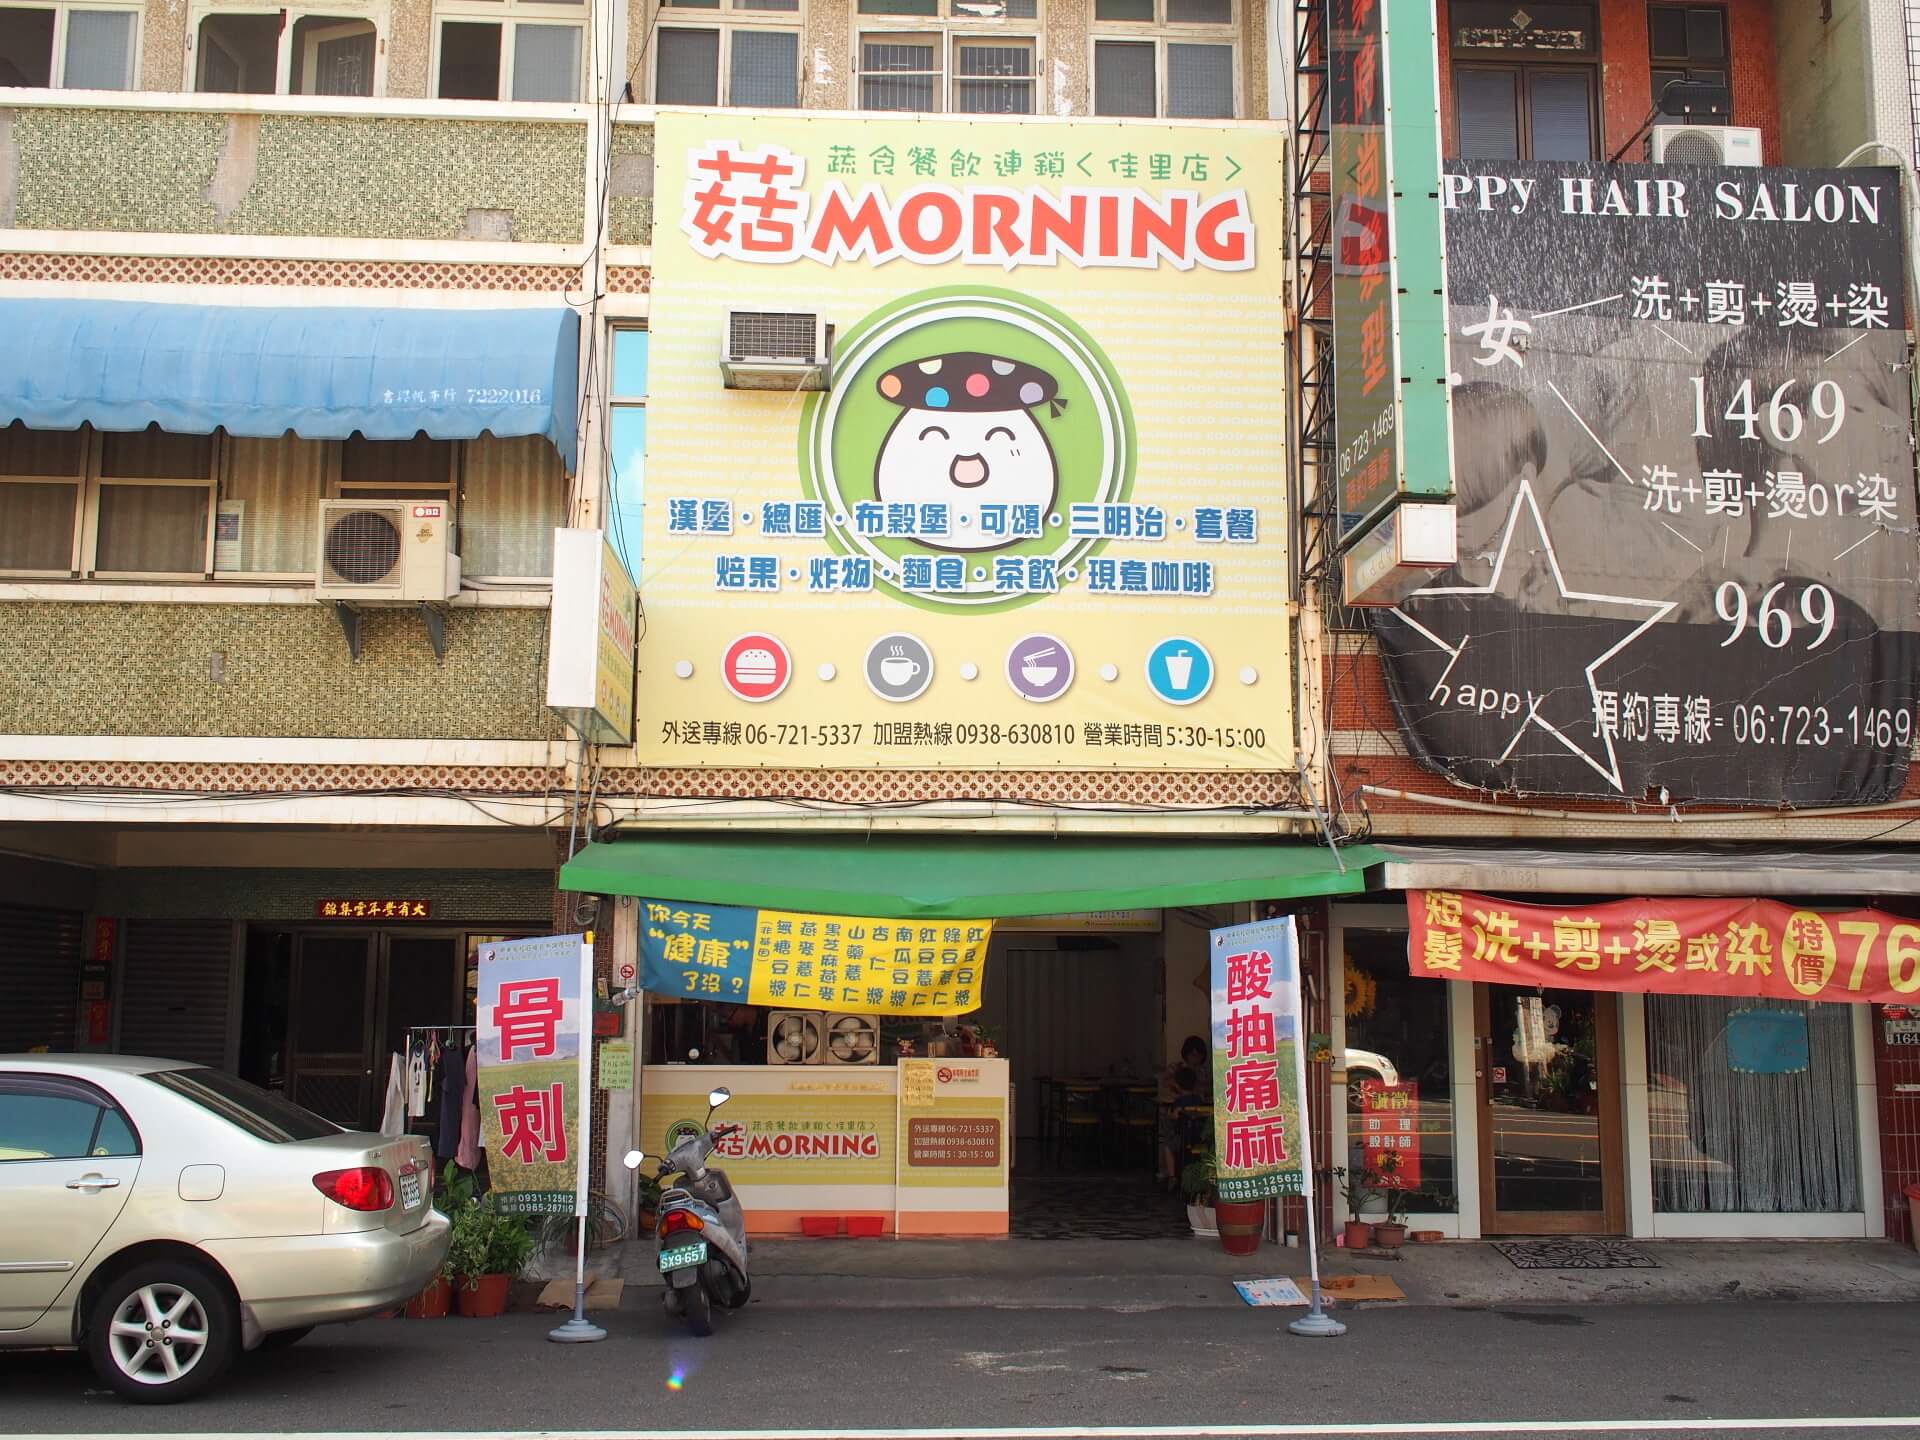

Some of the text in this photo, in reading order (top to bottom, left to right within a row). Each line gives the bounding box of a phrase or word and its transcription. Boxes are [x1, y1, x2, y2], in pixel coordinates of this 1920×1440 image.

[1560, 178, 1688, 217] HAIR
[1715, 181, 1881, 224] SALON
[1461, 293, 1532, 369] 女
[467, 388, 541, 405] 7222016
[1689, 376, 1846, 444] 1469
[1714, 581, 1835, 649] 969
[647, 903, 711, 931] 你今天
[1424, 891, 1463, 972] 短髮
[1791, 918, 1826, 987] 特價
[493, 979, 566, 1162] 骨刺
[1224, 951, 1287, 1169] 酸抽痛麻
[660, 1248, 706, 1269] SX9-657
